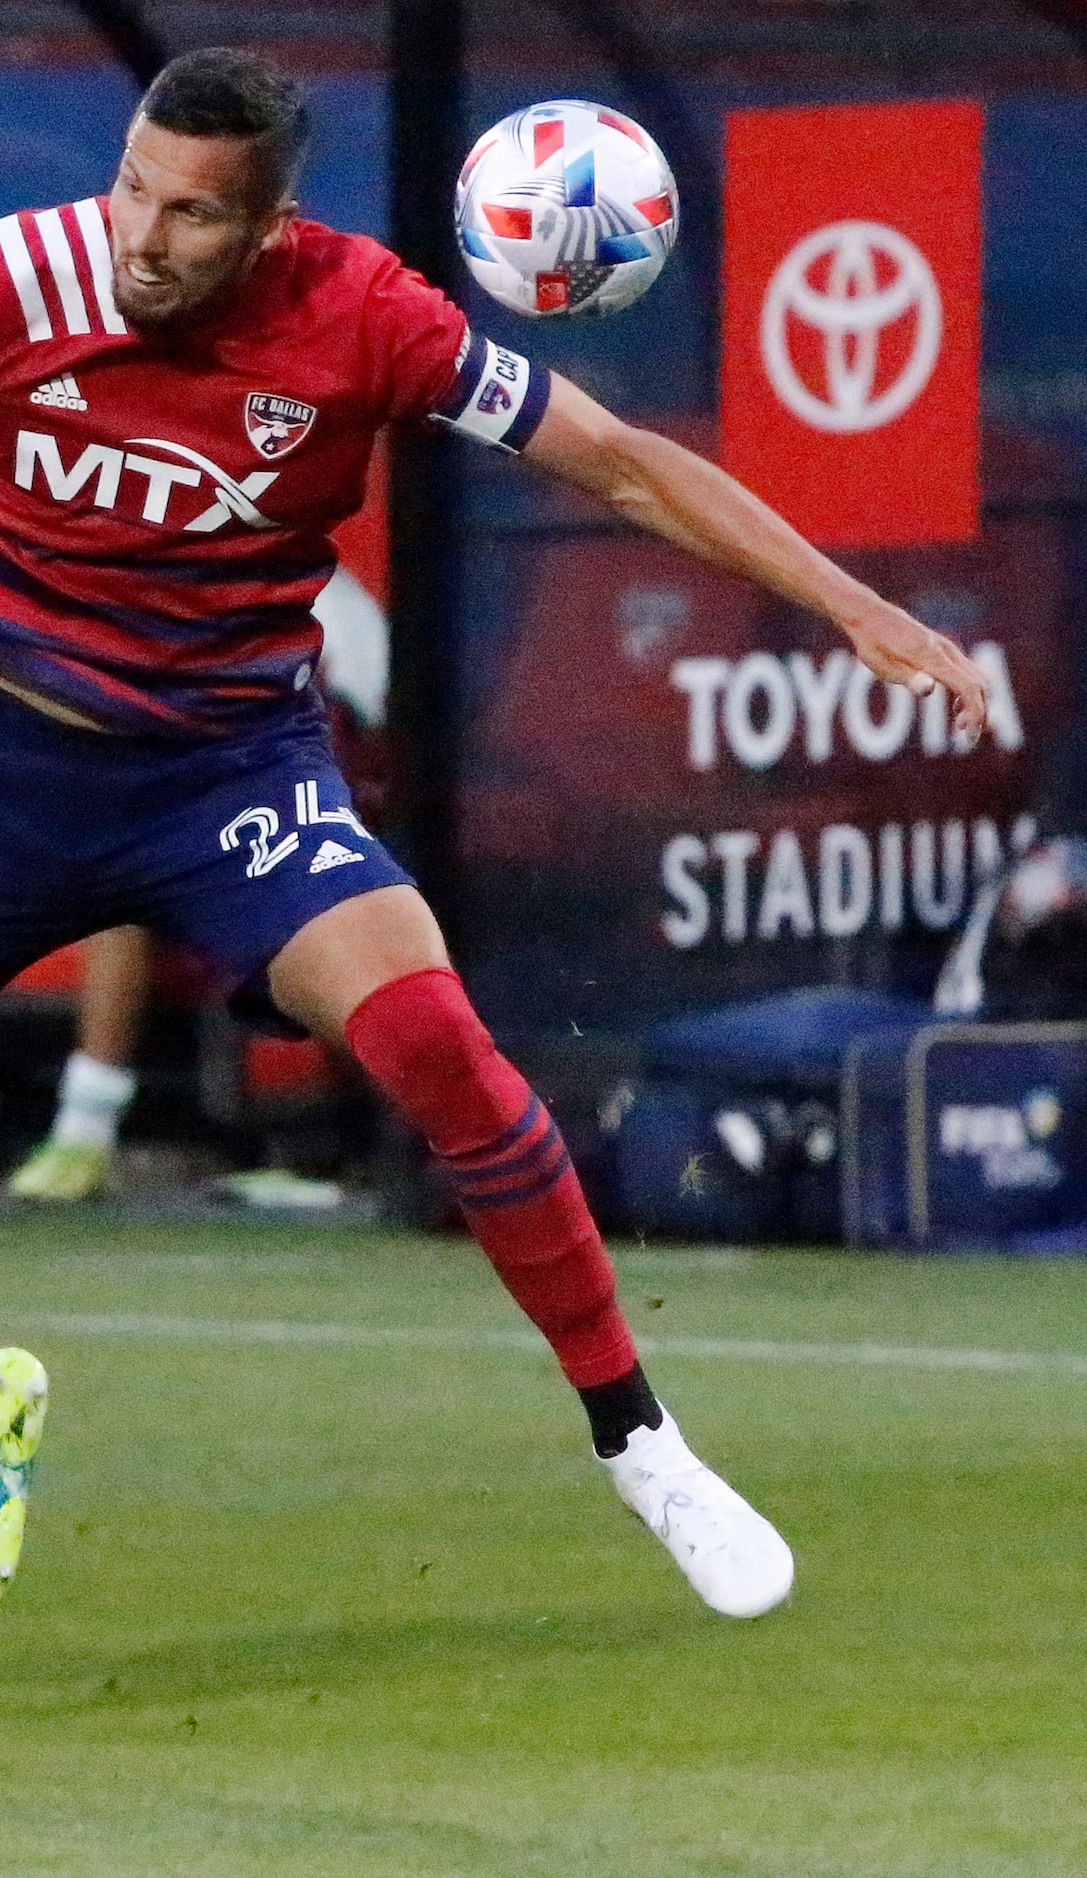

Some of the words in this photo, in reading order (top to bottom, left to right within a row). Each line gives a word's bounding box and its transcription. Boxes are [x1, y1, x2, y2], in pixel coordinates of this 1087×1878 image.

[30, 391, 88, 412] adidas
[251, 396, 267, 411] FC
[269, 399, 310, 422] DALLAS
[14, 429, 281, 533] MTX
[219, 780, 375, 878] 24
